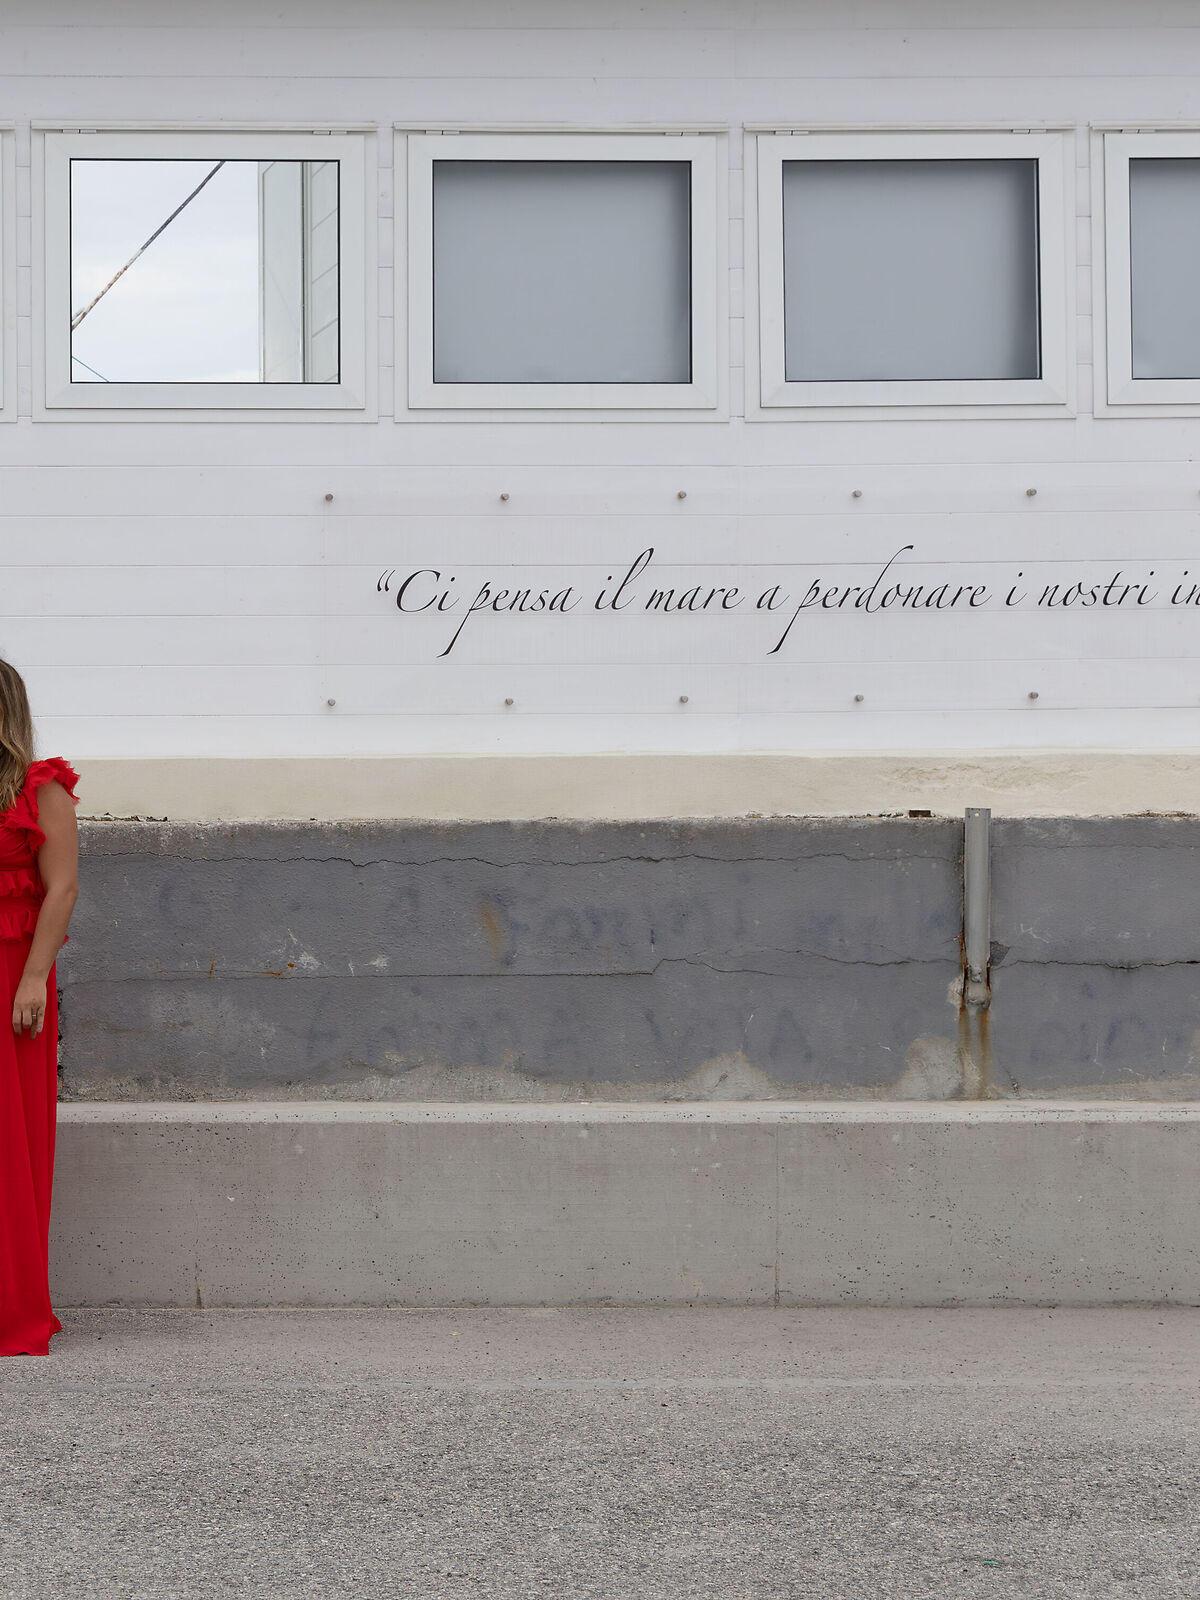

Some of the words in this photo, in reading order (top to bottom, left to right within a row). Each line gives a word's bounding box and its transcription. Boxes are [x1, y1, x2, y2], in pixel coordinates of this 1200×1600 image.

[377, 569, 458, 613] “Ci
[594, 547, 655, 611] il
[645, 585, 744, 612] mare
[755, 584, 790, 610] a
[1005, 572, 1027, 606] i
[1038, 570, 1158, 608] nostri
[437, 581, 582, 658] pensa
[767, 545, 992, 655] perdonare
